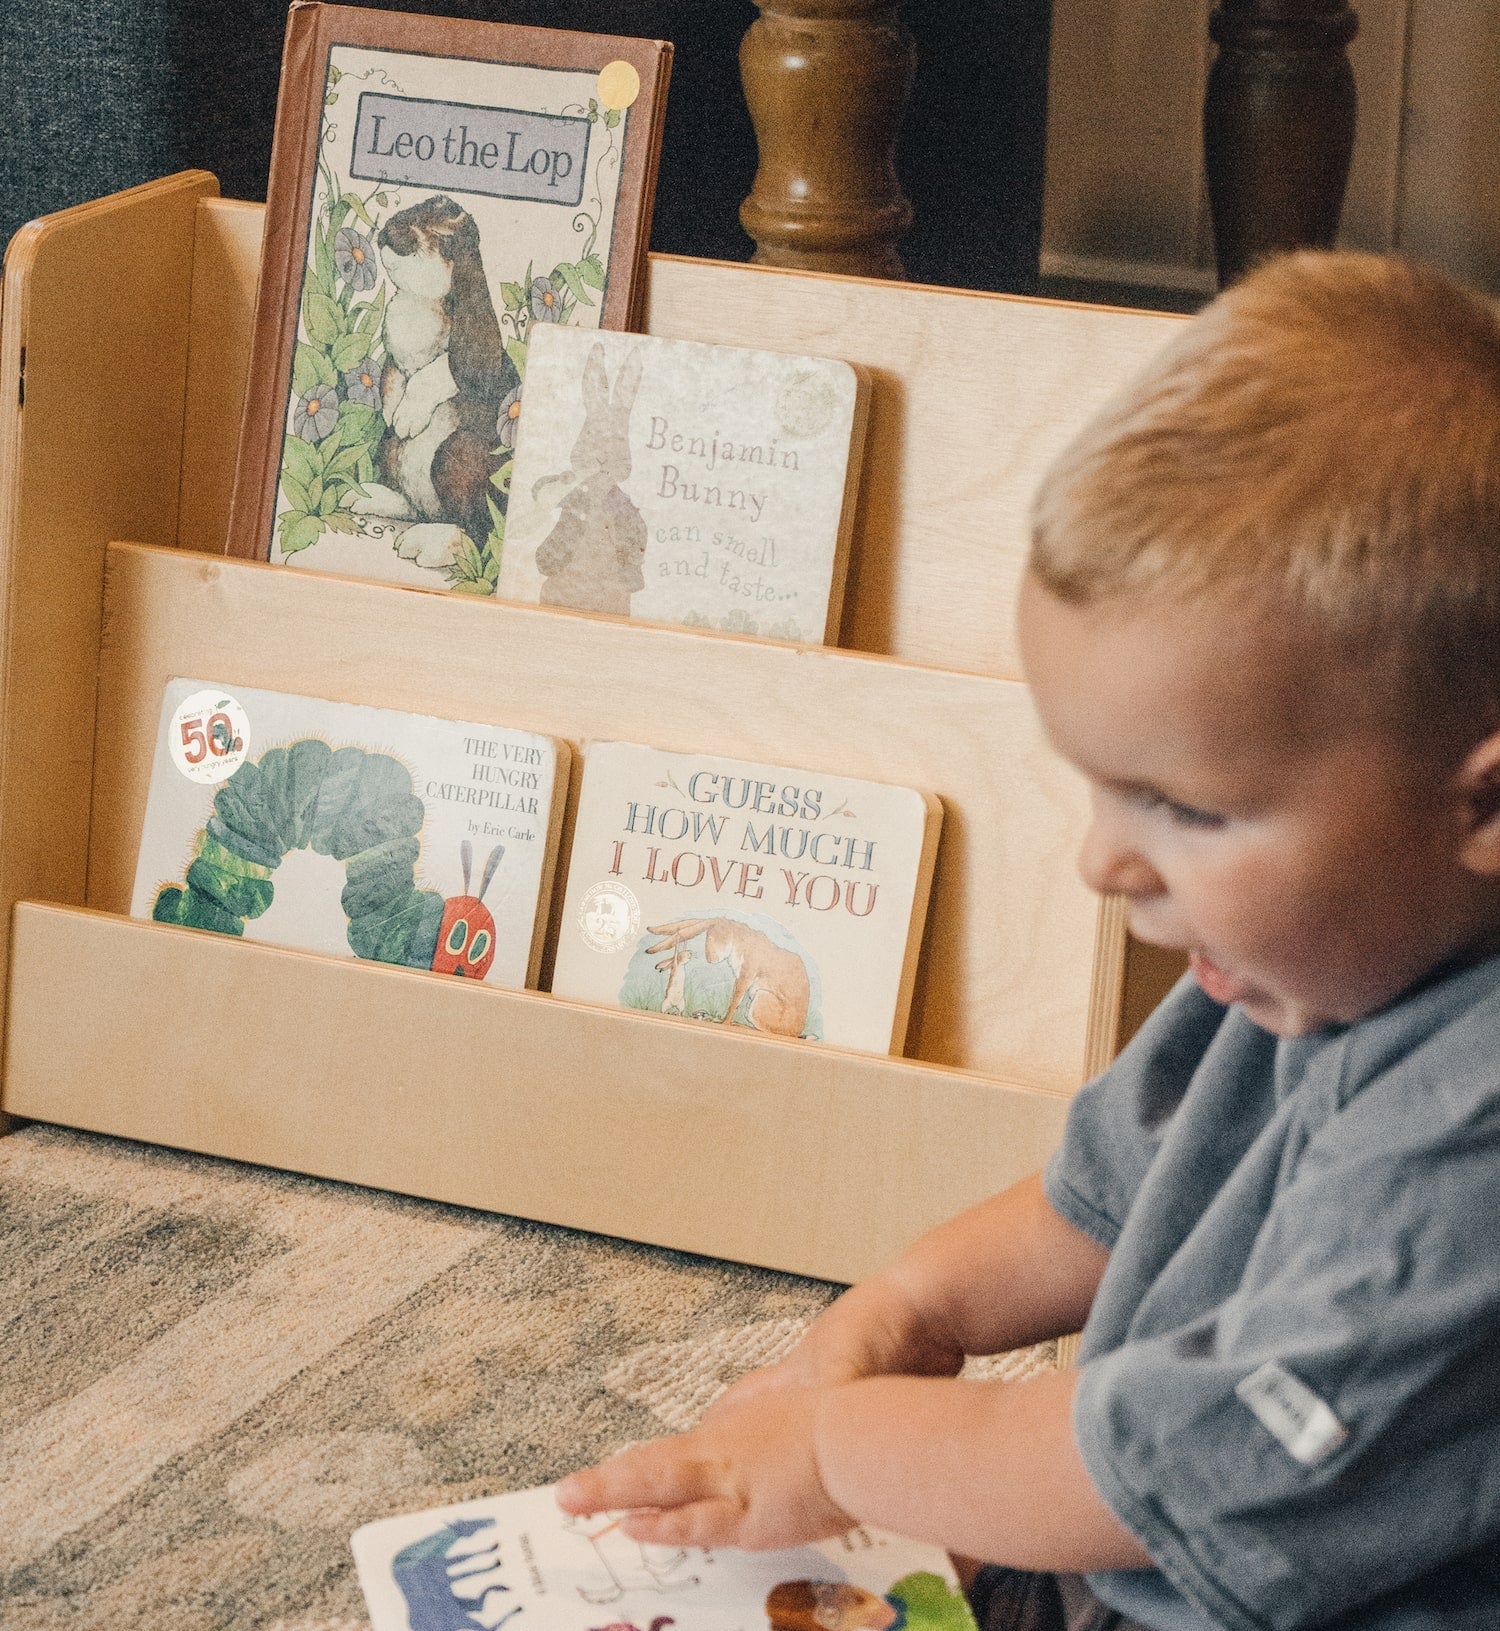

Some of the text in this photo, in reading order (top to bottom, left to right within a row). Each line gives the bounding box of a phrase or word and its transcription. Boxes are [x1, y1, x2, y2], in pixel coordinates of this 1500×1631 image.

[367, 115, 573, 187] Leo the Lop
[645, 416, 800, 471] Benjamin
[656, 464, 768, 523] Bunny
[655, 525, 779, 568] can smell
[658, 551, 710, 579] and
[180, 712, 233, 764] 50
[463, 737, 547, 766] THE VERY
[426, 781, 539, 815] CATERPILLAR
[472, 763, 543, 790] HUNGRY
[688, 771, 823, 821] GUESS
[467, 819, 536, 841] by Eric Carle
[622, 801, 878, 871] HOW MUCH
[608, 840, 881, 917] I LOVE YOU
